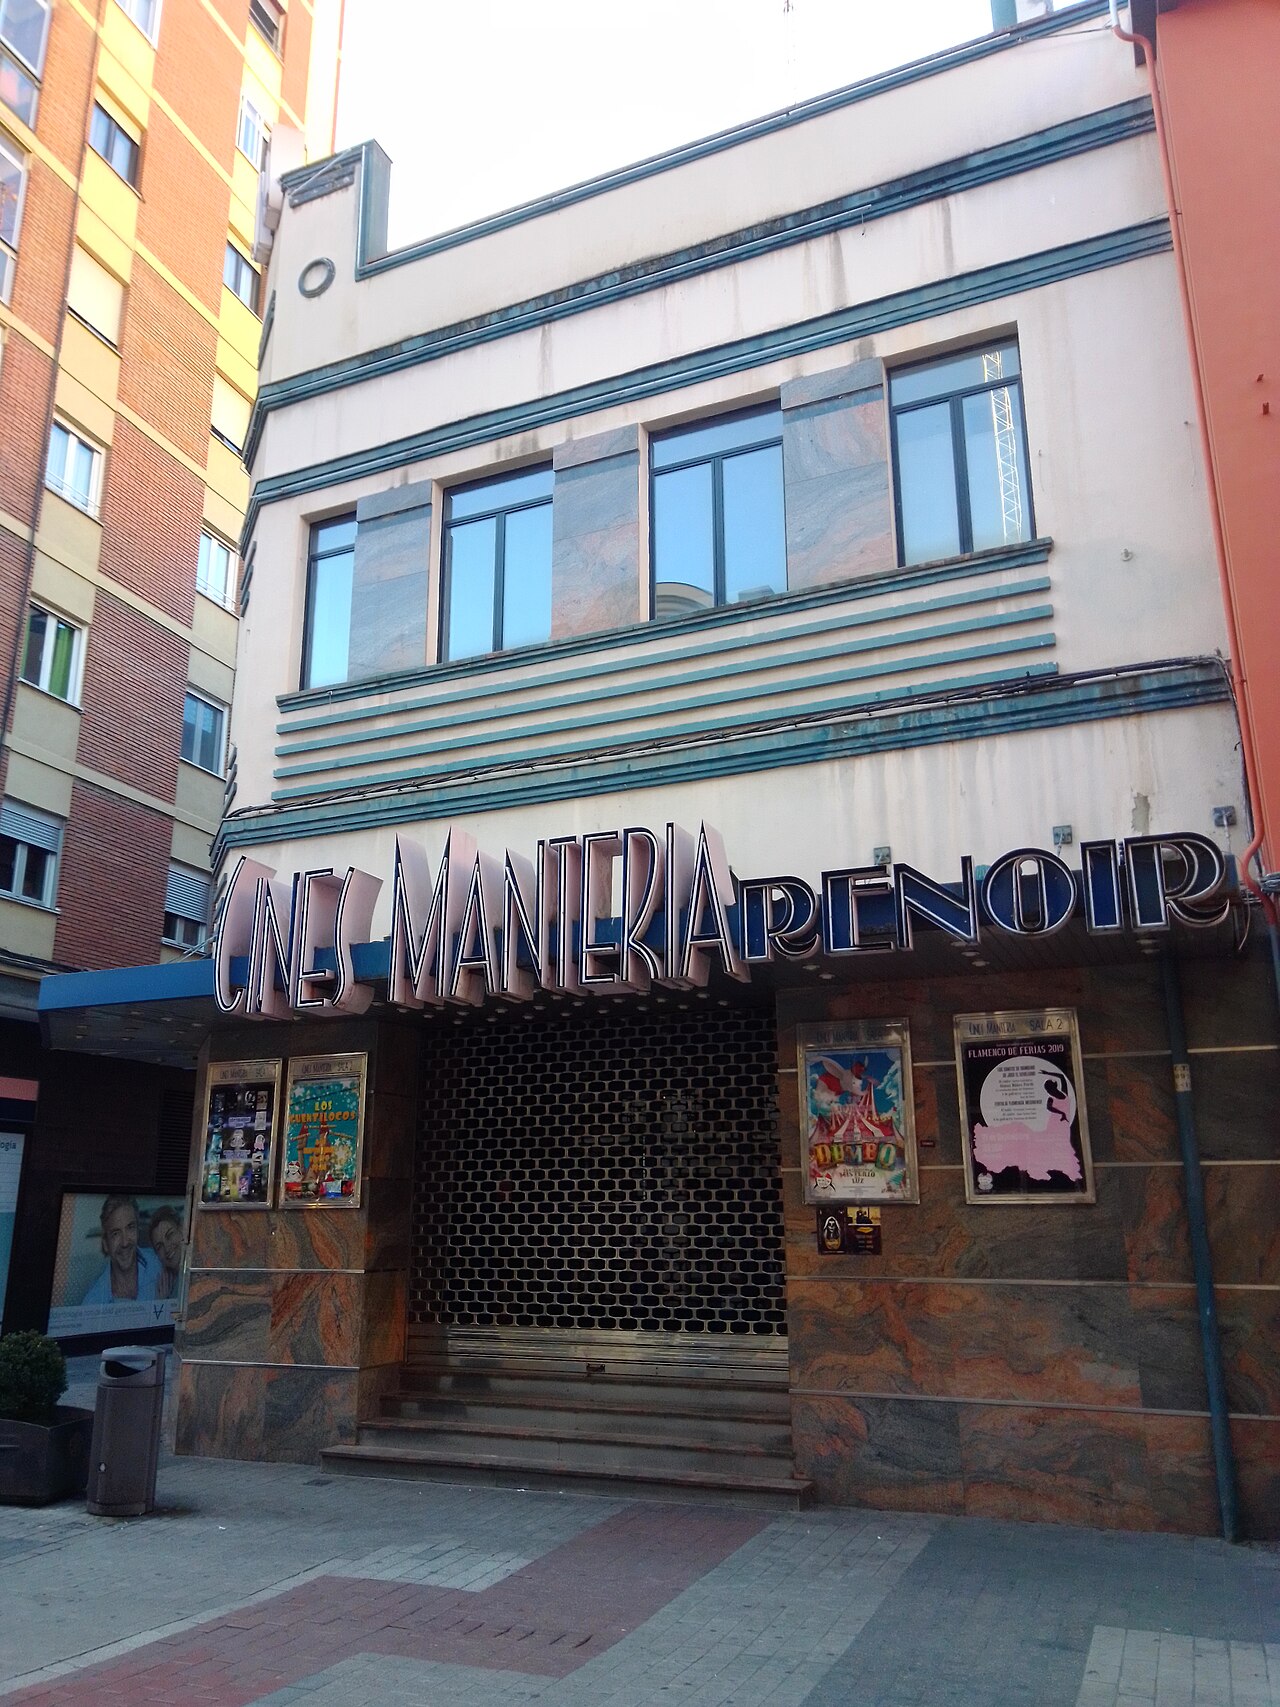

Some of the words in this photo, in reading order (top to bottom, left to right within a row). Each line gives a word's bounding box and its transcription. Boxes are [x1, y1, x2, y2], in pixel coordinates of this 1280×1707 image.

[213, 855, 368, 1015] CINES
[386, 818, 746, 1005] MANTERIA
[738, 830, 1231, 964] RENOIR
[1030, 1018, 1053, 1031] SALA
[1056, 1018, 1063, 1030] 2
[968, 1047, 1006, 1058] FLAMENCO
[1008, 1046, 1018, 1056] DE
[1019, 1044, 1046, 1055] FERIAS
[1047, 1044, 1064, 1053] 2019
[314, 1100, 333, 1111] LOS
[289, 1111, 356, 1123] CUENTILOCOS
[815, 1142, 896, 1168] DUMBO
